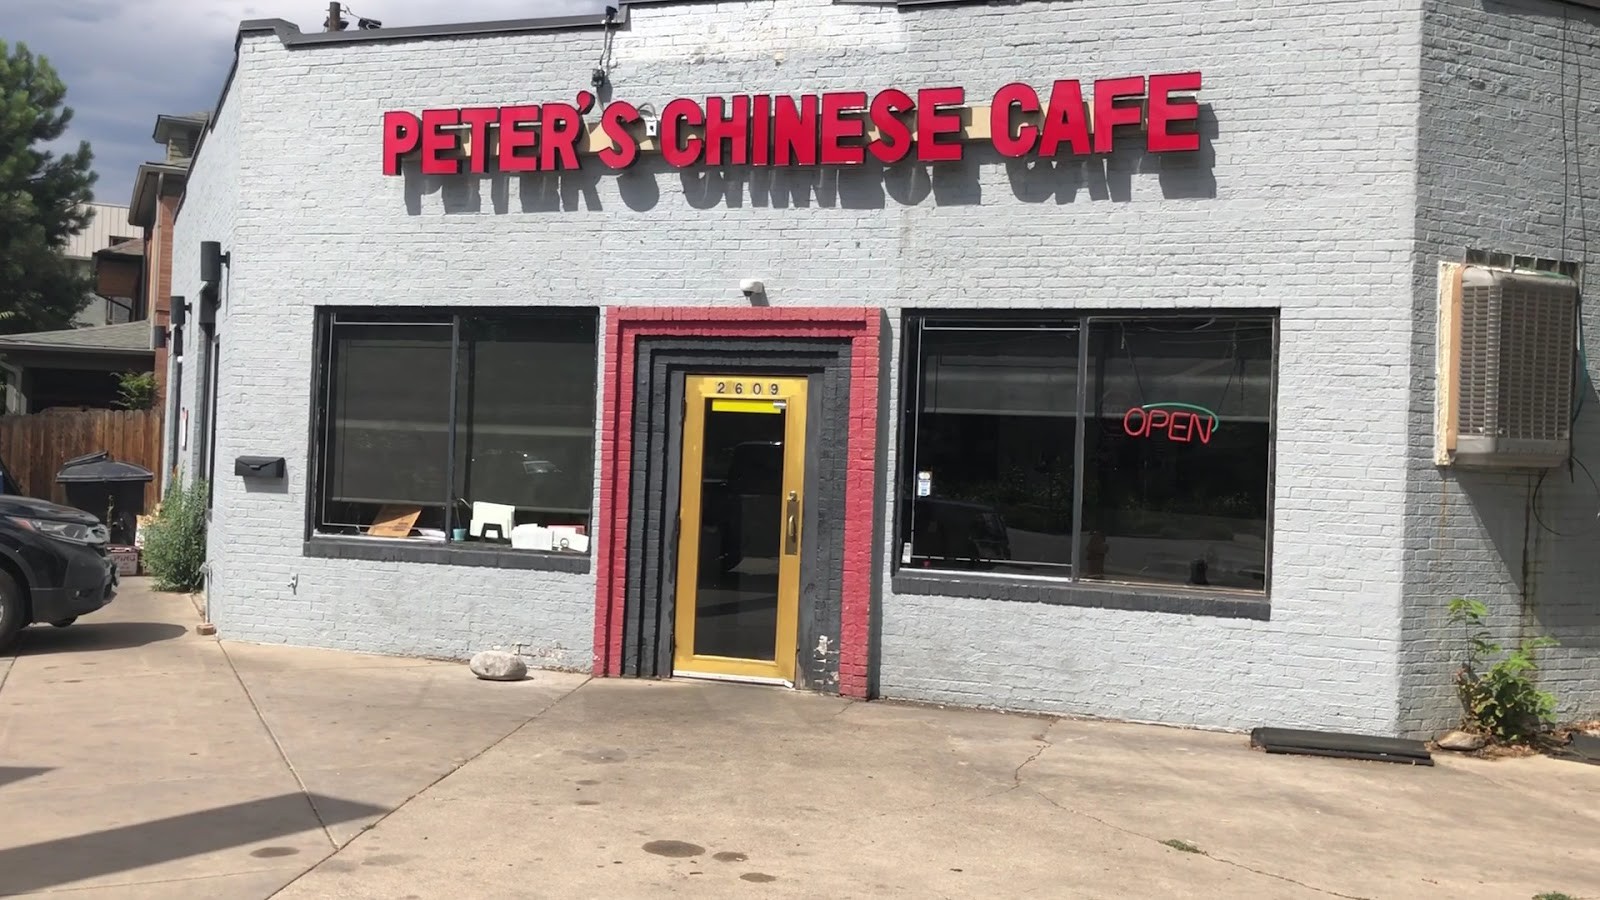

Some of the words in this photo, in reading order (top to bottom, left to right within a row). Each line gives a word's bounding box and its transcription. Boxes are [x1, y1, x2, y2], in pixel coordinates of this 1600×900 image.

[382, 90, 640, 176] PETER'S
[660, 86, 966, 168] CHINESE
[990, 72, 1202, 158] CAFE
[716, 381, 779, 396] 2609
[1123, 407, 1214, 445] OPEN
